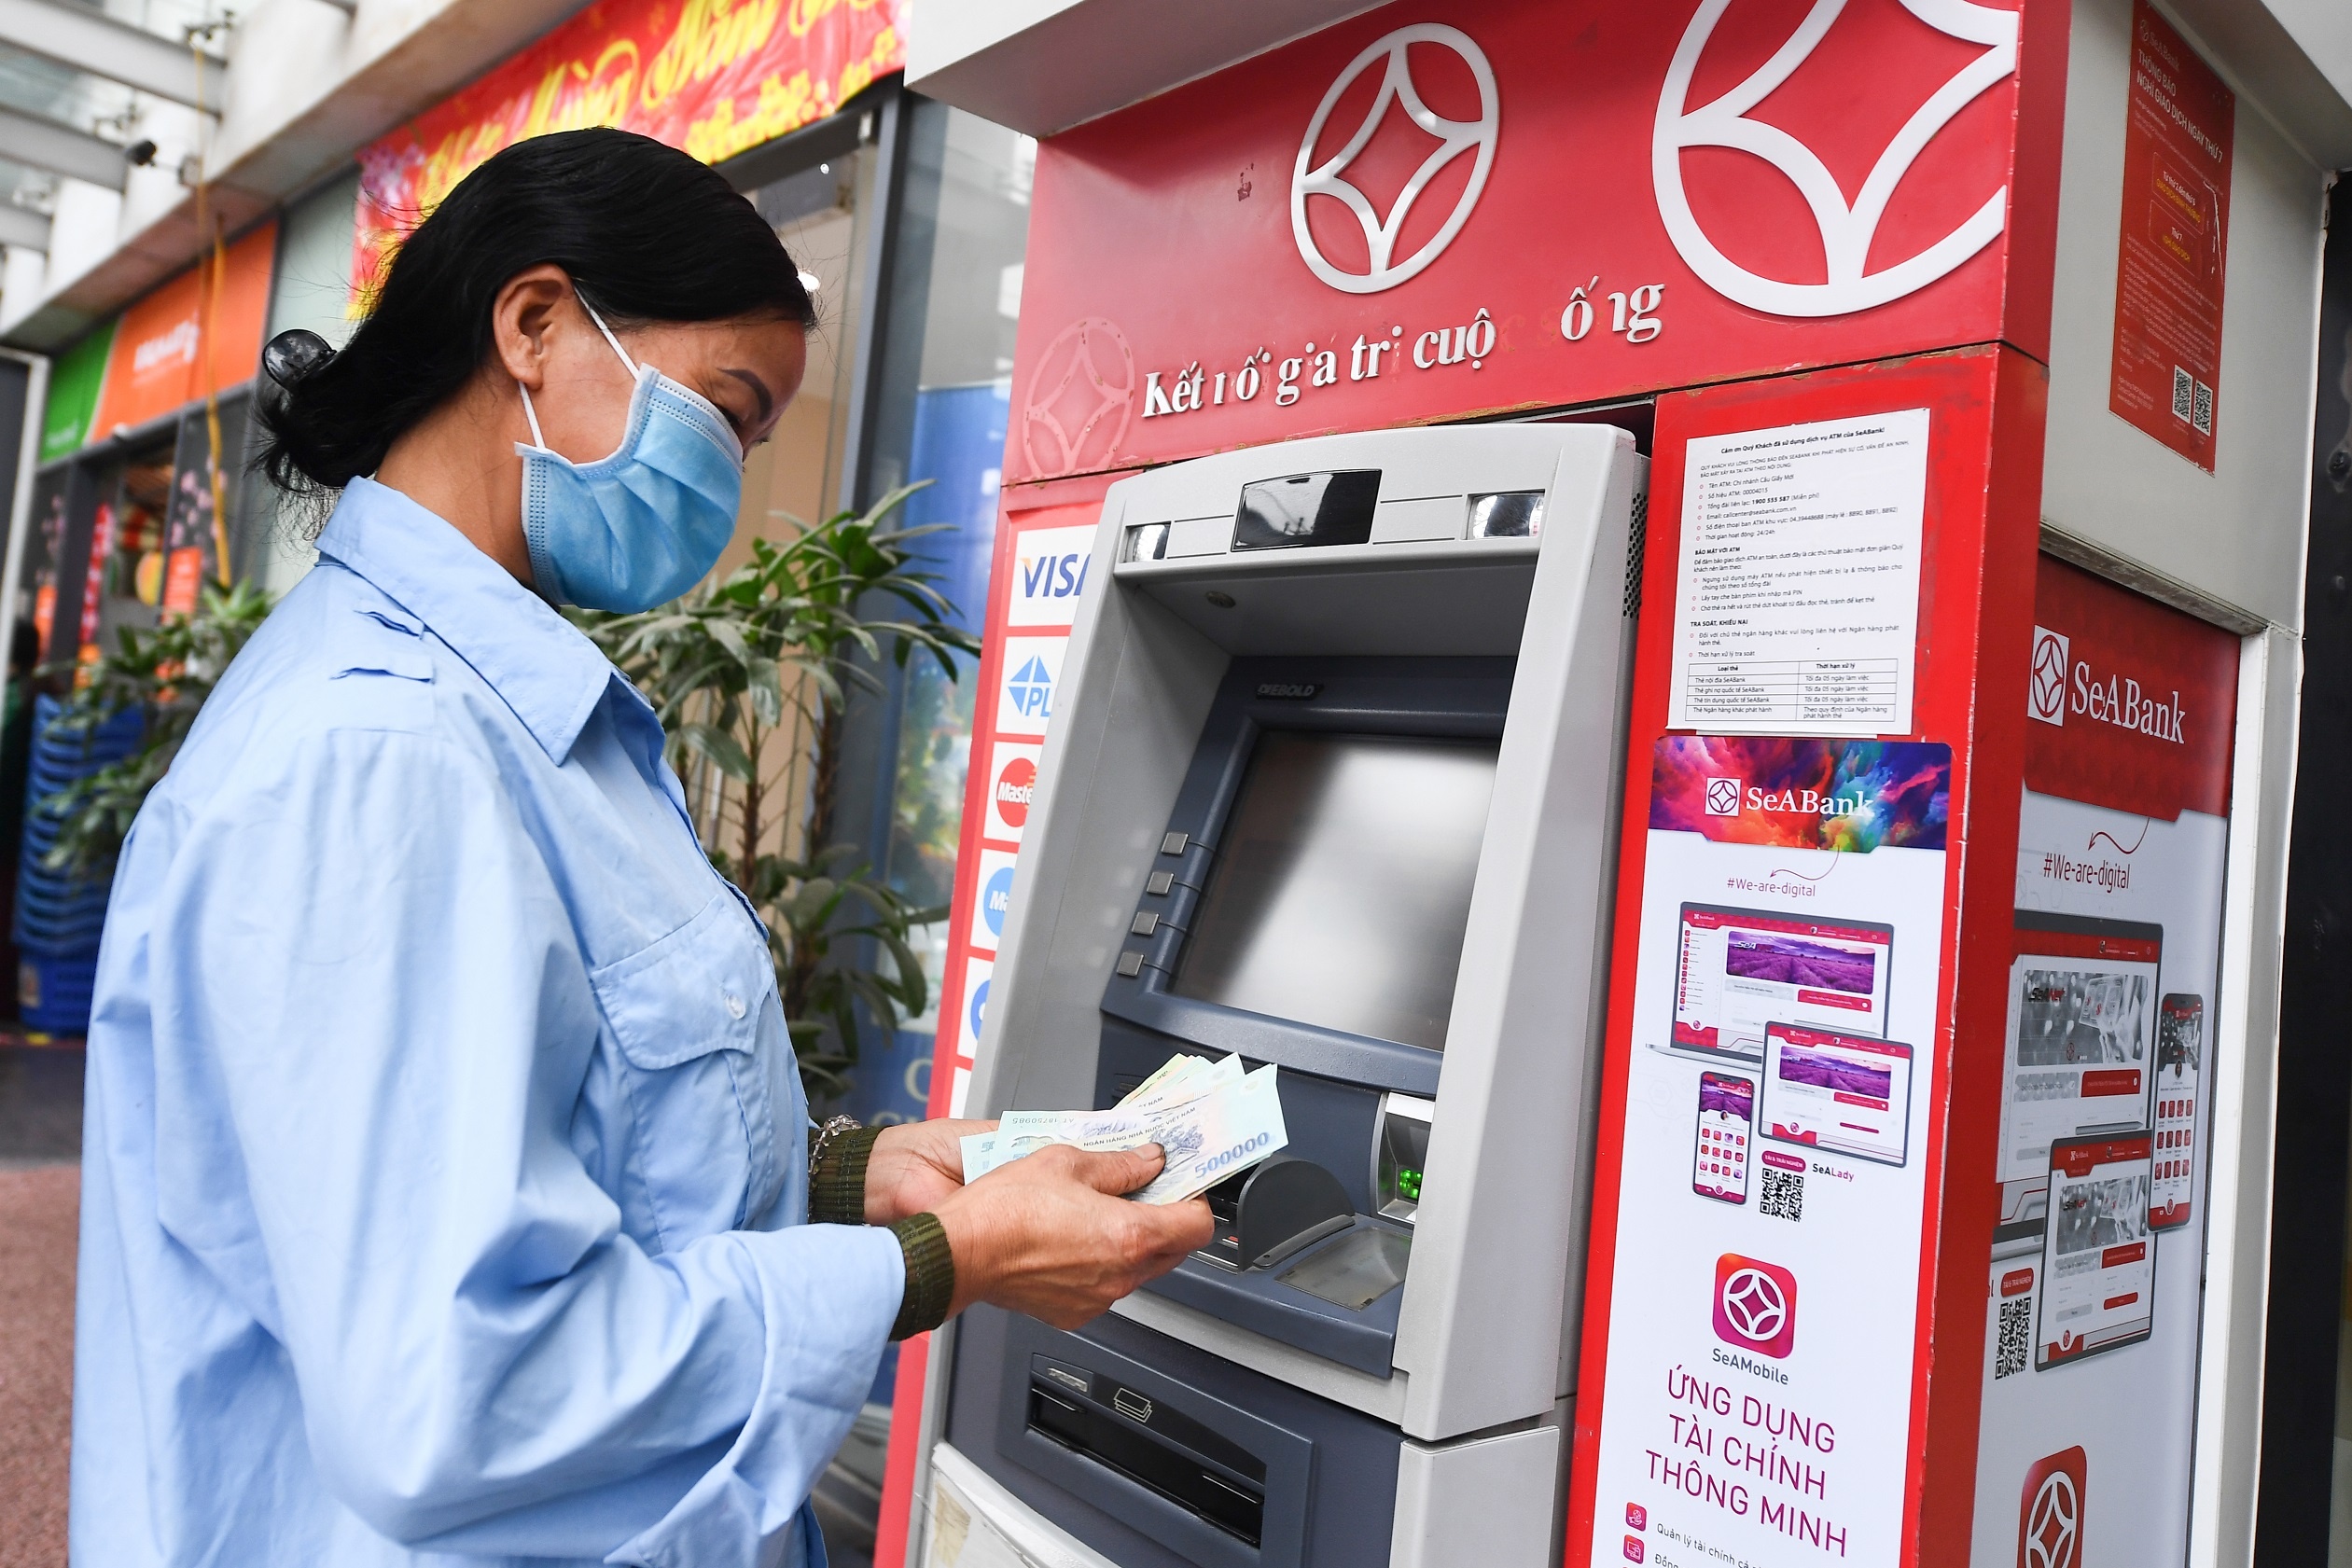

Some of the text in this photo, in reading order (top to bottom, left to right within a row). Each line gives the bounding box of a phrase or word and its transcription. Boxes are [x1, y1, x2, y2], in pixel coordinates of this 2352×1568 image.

[2138, 49, 2162, 82] THÔNG
[2162, 74, 2177, 97] BÁO
[2154, 89, 2171, 113] GIAO
[2171, 104, 2187, 130] DỊCH
[2219, 149, 2223, 163] 7
[1257, 684, 1315, 697] DIEBOLD
[2071, 660, 2186, 744] SeABank
[1746, 785, 1875, 818] SeABank
[1726, 877, 1816, 897] #We-are-digital
[2043, 852, 2131, 894] #We-are-digital
[1083, 1139, 1105, 1147] NGÂN
[1106, 1134, 1127, 1145] HÀNG
[1181, 1106, 1196, 1118] NAM
[1195, 1131, 1270, 1179] 500000
[1812, 1163, 1854, 1182] SeALady
[1712, 1348, 1788, 1385] SeAMobile
[1667, 1364, 1834, 1453] ỨNG DỤNG
[1669, 1413, 1826, 1500] TÀI CHÍNH
[1645, 1450, 1847, 1558] THÔNG MINH
[1657, 1523, 1680, 1542] Quản
[1683, 1533, 1691, 1547] lý
[1694, 1539, 1706, 1553] tài
[1708, 1547, 1735, 1566] chính
